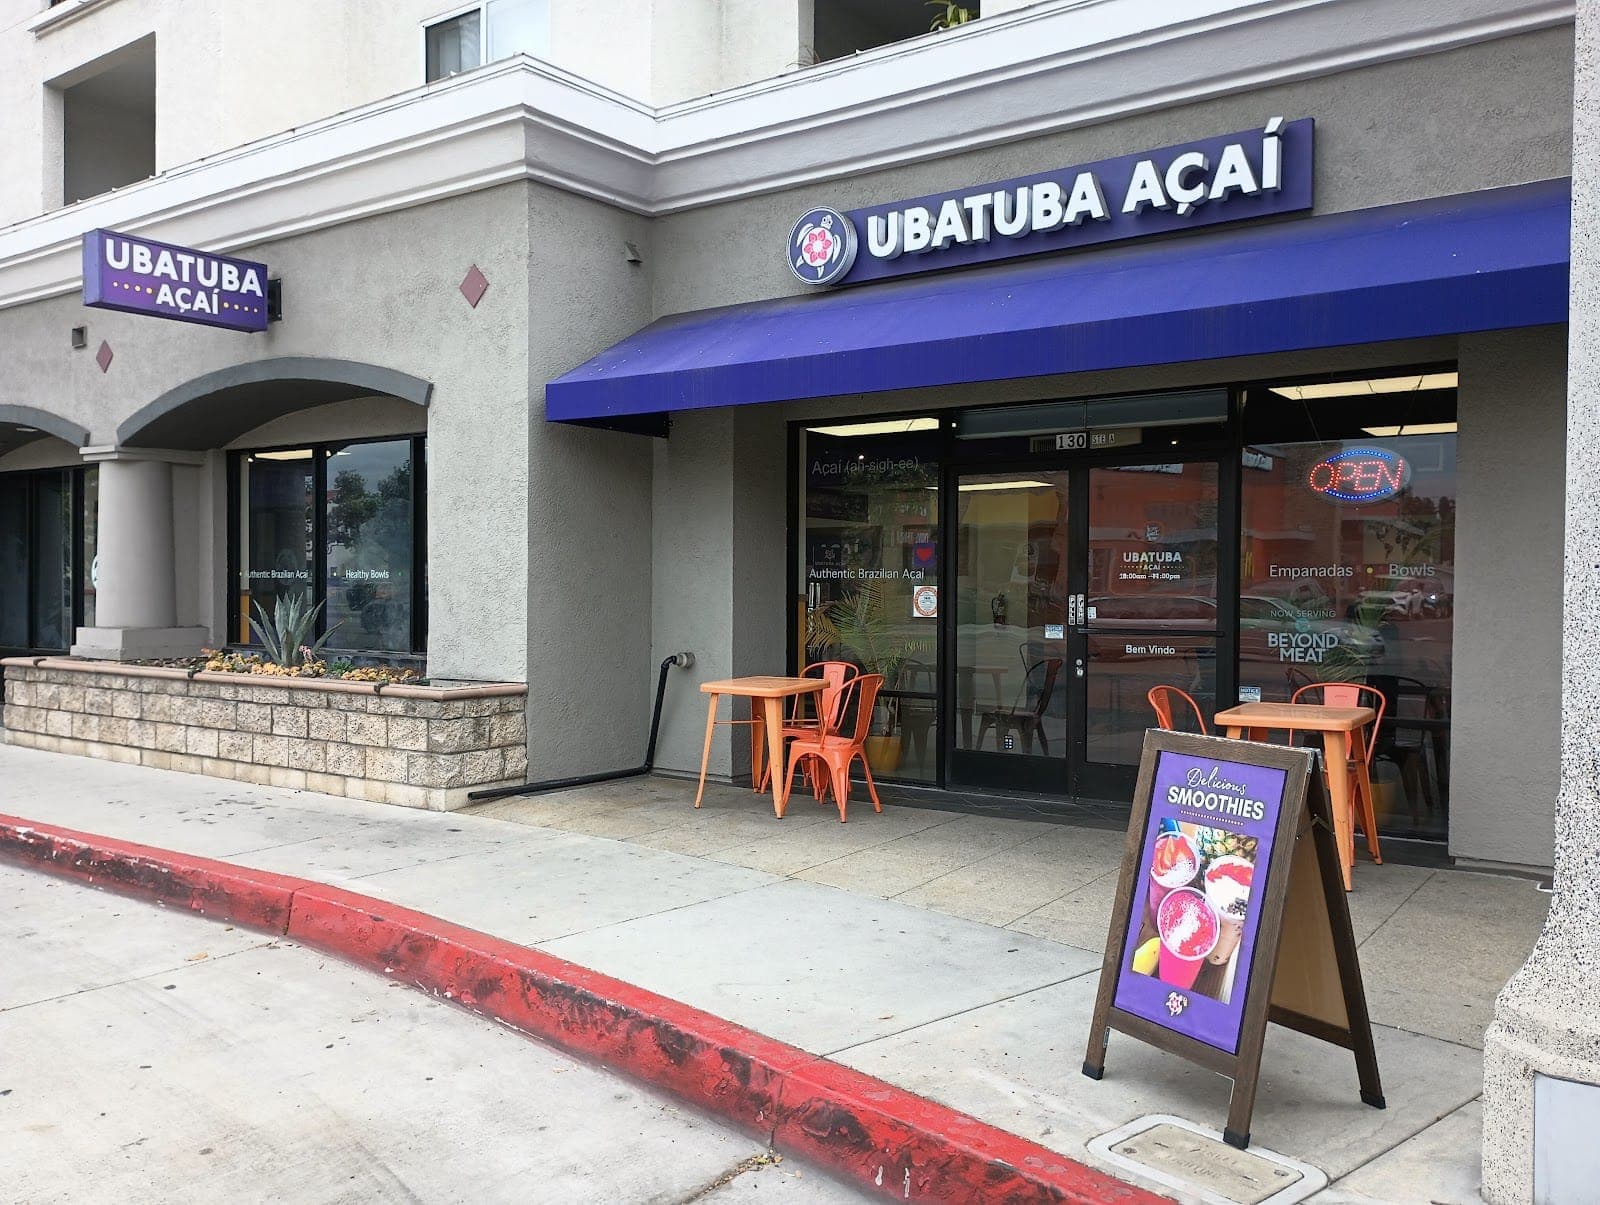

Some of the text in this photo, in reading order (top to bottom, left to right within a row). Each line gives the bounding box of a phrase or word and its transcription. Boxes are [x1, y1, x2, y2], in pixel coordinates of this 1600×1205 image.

[867, 117, 1284, 258] UBATUBA AÇAÍ
[105, 238, 264, 297] UBATUBA
[156, 283, 220, 315] AÇAÍ
[1058, 434, 1085, 449] 130
[1309, 459, 1404, 492] OPEN
[1123, 551, 1182, 563] UBATUBA
[345, 569, 390, 581] Healthy Bowls
[809, 567, 856, 579] Authentic
[858, 567, 899, 579] Brazilian
[1269, 563, 1436, 581] Empanadas Bowls
[1270, 610, 1336, 618] NOW SERVING
[1268, 633, 1339, 649] BEYOND
[1125, 644, 1176, 655] Bem Vindo
[1280, 647, 1326, 663] MEAT
[1187, 766, 1247, 796] Delicious
[1167, 786, 1265, 820] SMOOTHIES
